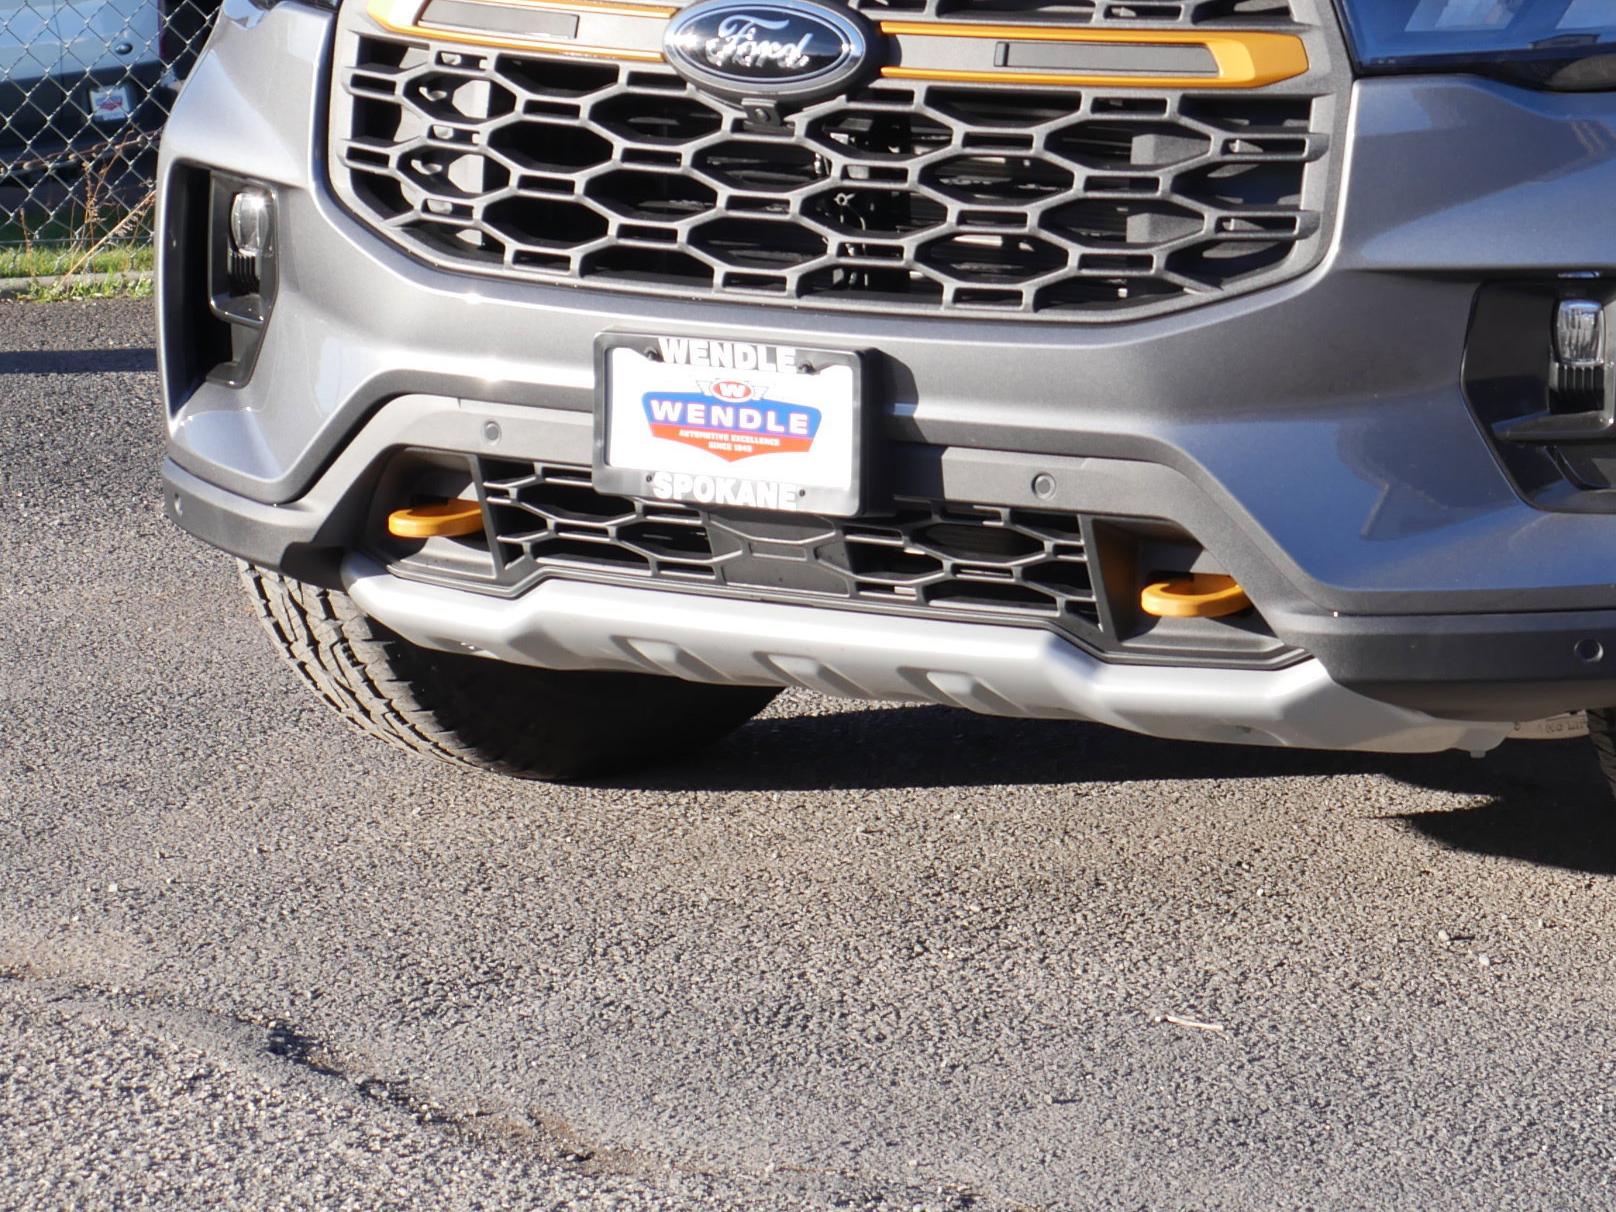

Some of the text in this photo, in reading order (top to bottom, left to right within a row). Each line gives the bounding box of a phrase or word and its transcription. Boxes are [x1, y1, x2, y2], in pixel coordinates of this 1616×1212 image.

[705, 14, 813, 68] Ford
[658, 337, 798, 374] WENDLE
[650, 399, 809, 435] WENDLE
[678, 429, 780, 446] AUTOMOTIVE EXCELLENCE
[651, 470, 798, 511] SPOKANE
